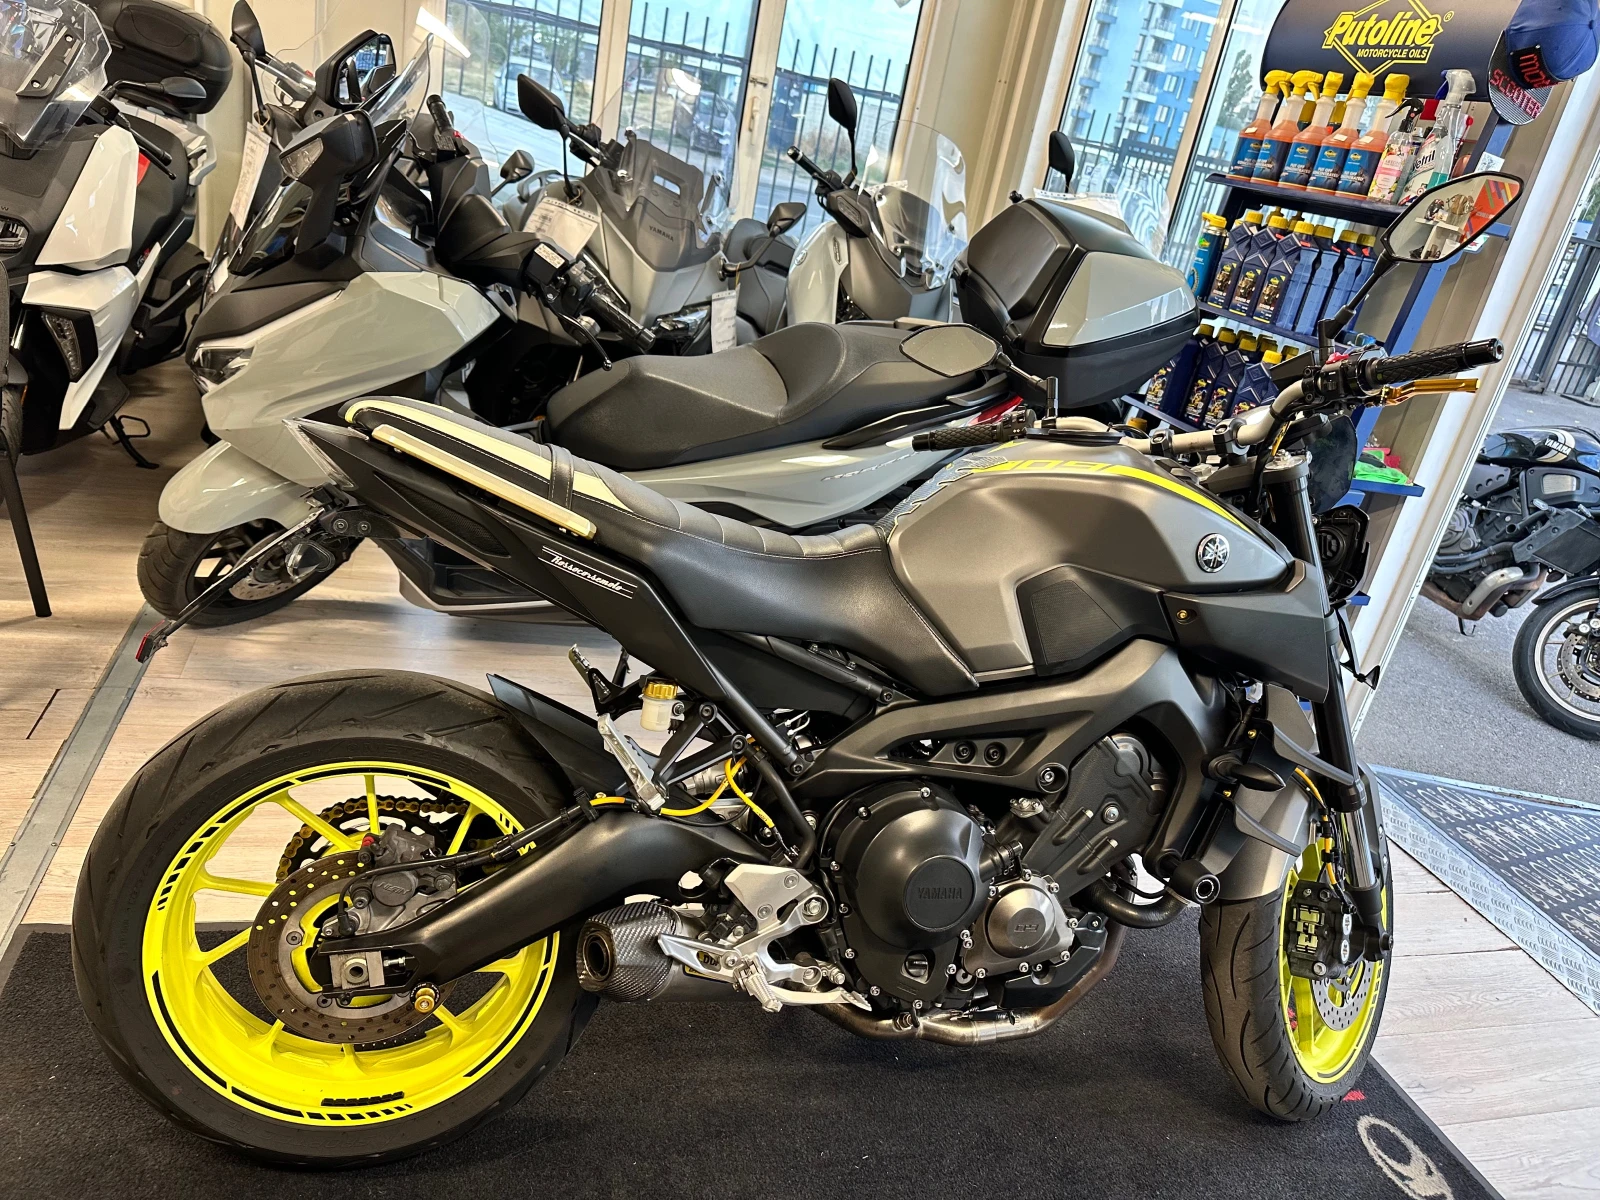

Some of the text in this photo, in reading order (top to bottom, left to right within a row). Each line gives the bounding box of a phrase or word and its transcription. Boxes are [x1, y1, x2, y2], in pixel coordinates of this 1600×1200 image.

[1325, 11, 1438, 46] Putoline
[1356, 48, 1428, 58] MOTORCYCLE OILS
[1489, 68, 1542, 119] SCOOTER
[648, 224, 675, 243] YAMAHA
[1544, 438, 1572, 456] YAMAHA
[917, 887, 963, 900] YAMAHA
